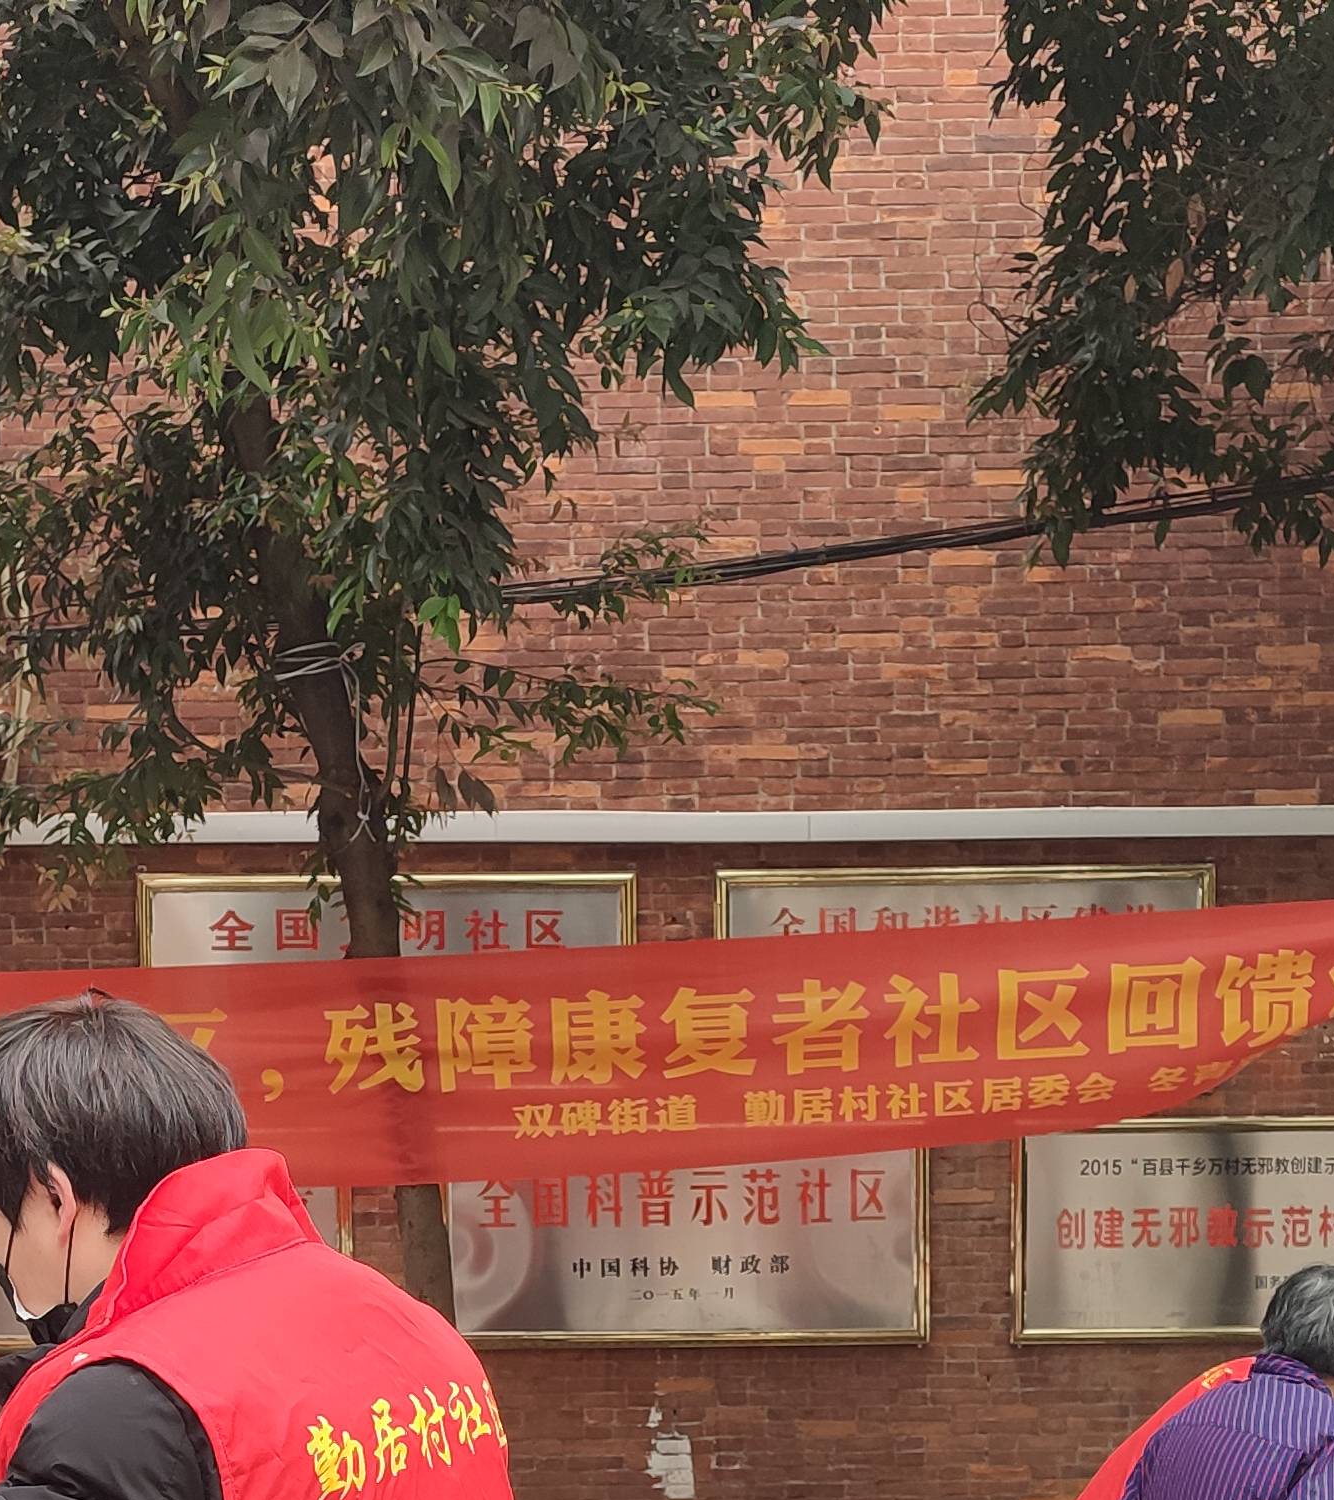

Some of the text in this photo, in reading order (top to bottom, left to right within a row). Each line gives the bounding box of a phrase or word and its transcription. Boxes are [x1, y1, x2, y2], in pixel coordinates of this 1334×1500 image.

[209, 909, 565, 951] 全国明社区
[513, 1094, 698, 1139] 双碑街道
[743, 1072, 1115, 1128] 勤居村社区居委会
[476, 1167, 887, 1229] 全国科普示范社区
[572, 1254, 790, 1279] 中国科协 财政部
